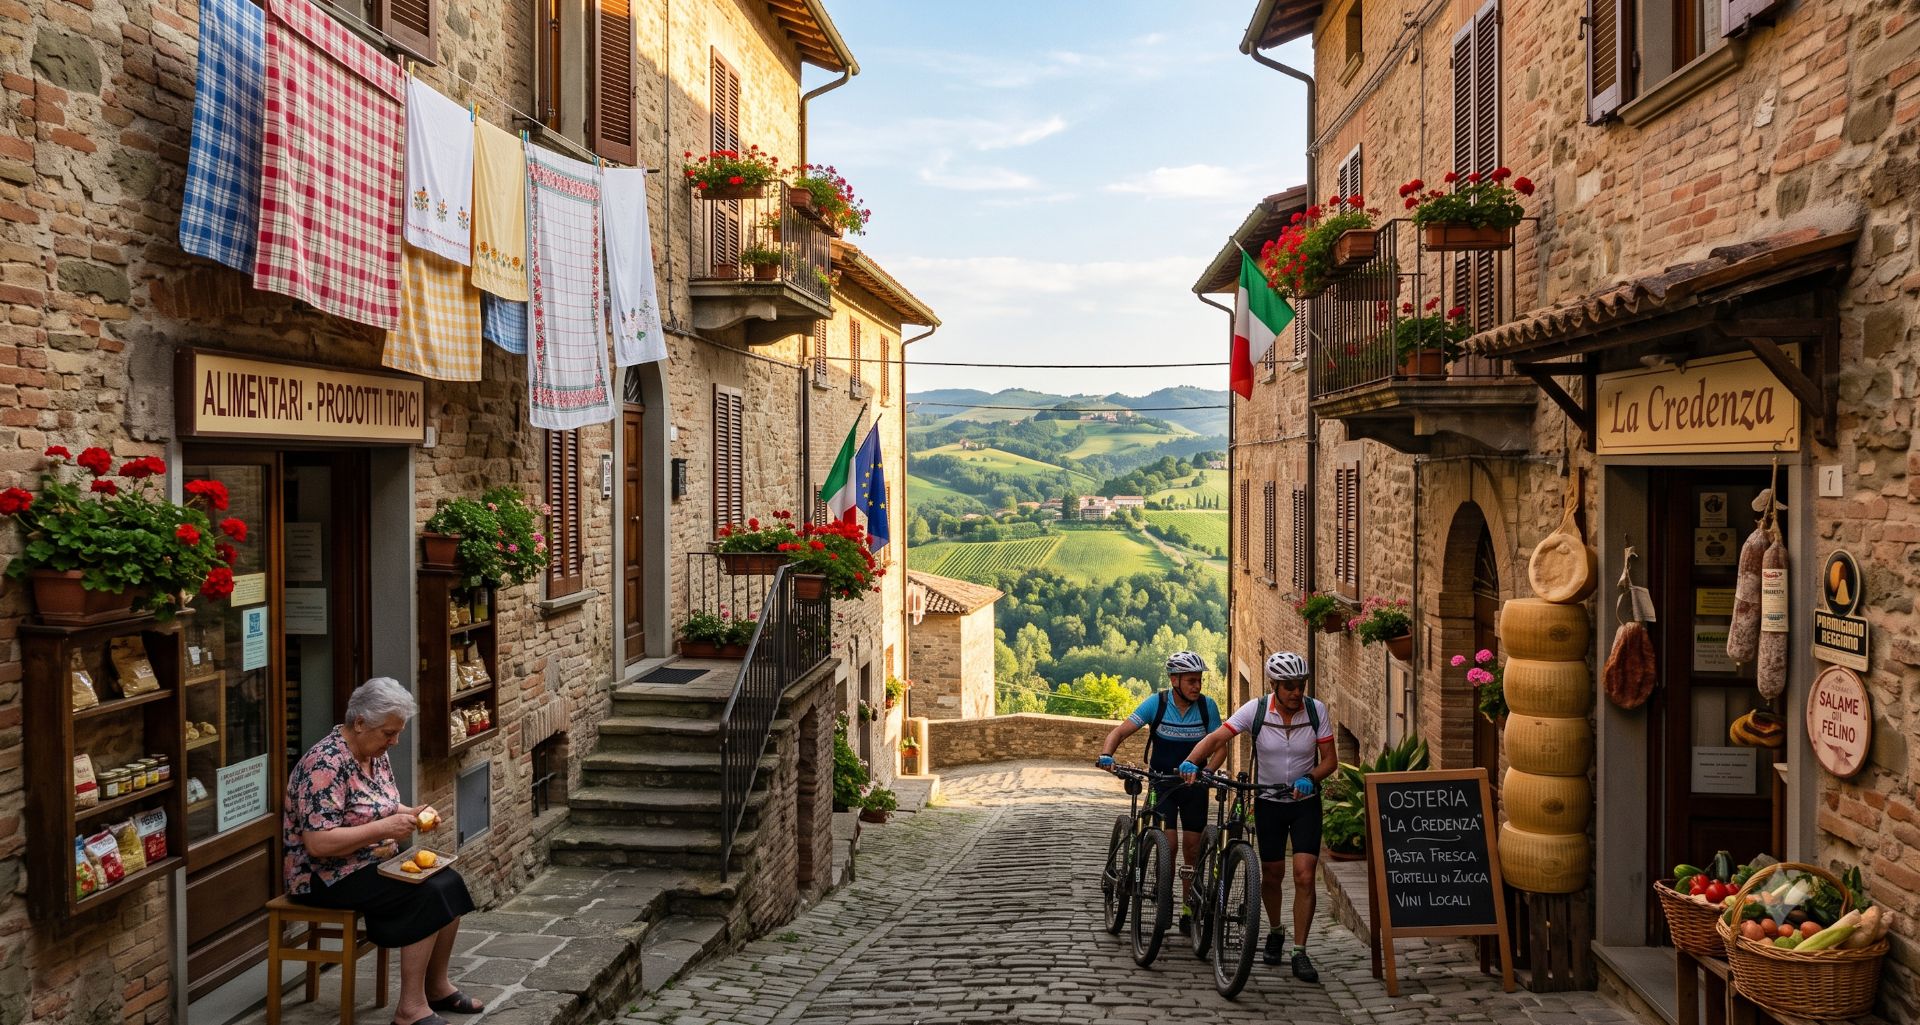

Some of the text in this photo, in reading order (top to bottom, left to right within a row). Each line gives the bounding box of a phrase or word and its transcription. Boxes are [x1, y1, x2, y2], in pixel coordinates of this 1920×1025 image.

[202, 369, 303, 421] ALIMENTARI
[317, 381, 383, 426] PRODOTTI
[386, 388, 420, 428] TIPICI
[1647, 376, 1775, 432] Credenza
[1827, 470, 1835, 491] 7
[1821, 629, 1859, 651] REGGIANO
[1819, 690, 1859, 716] SALAME
[1822, 719, 1856, 744] FELINO
[1388, 786, 1469, 809] OSTERIA
